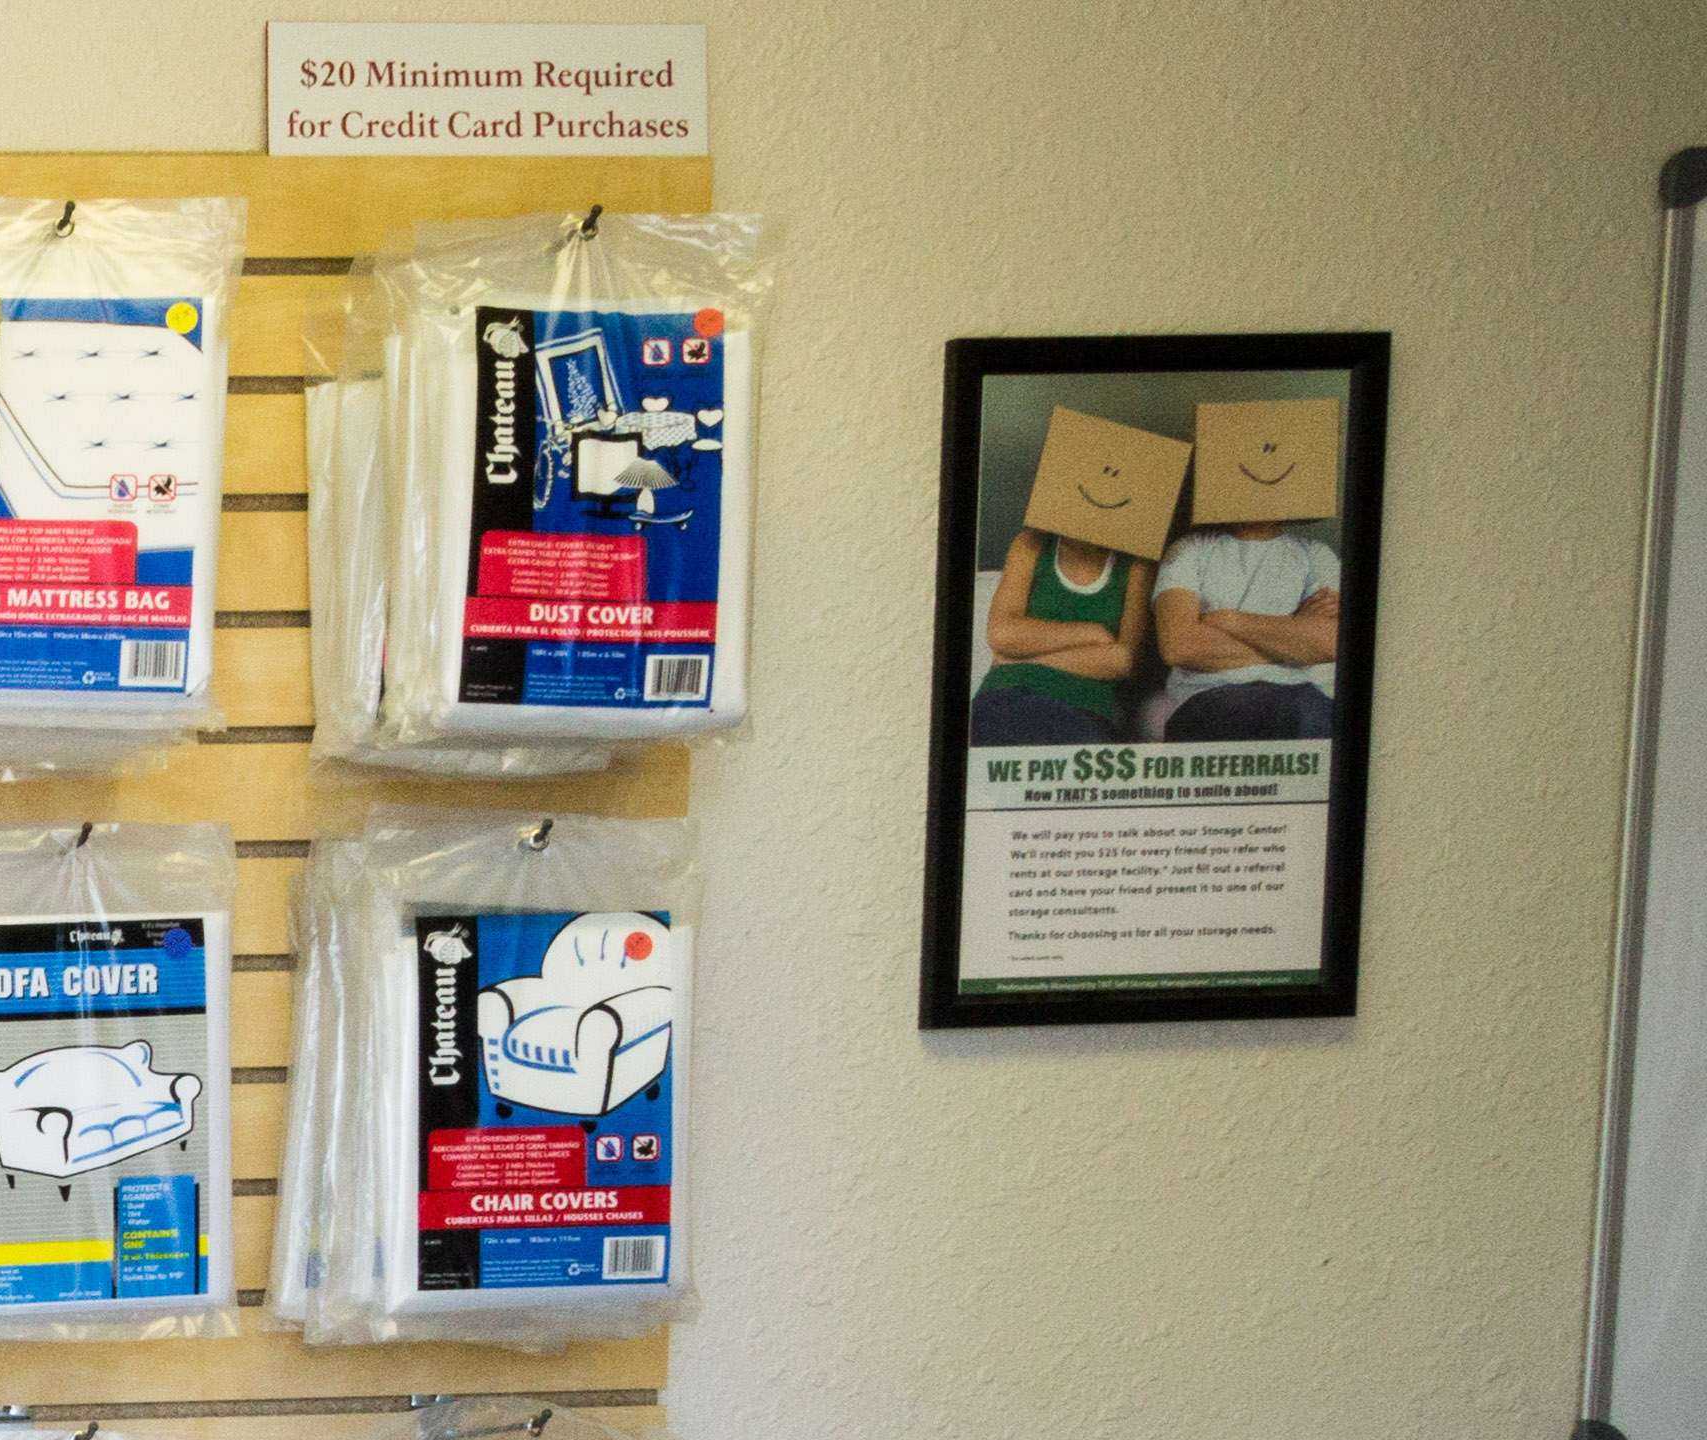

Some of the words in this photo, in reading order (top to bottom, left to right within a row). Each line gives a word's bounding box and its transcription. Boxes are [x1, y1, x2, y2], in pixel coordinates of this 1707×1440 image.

[300, 59, 355, 88] $20
[367, 61, 523, 88] Minimum
[534, 61, 674, 96] Required
[287, 110, 331, 138] for
[341, 111, 439, 138] Credit
[449, 112, 522, 138] Card
[533, 112, 689, 138] Purchases
[486, 356, 519, 485] Chateau
[7, 589, 118, 609] MATTRESS
[125, 591, 170, 609] BAG
[530, 603, 582, 622] DUST
[587, 605, 654, 625] COVER
[988, 761, 1021, 782] WE
[1028, 760, 1067, 781] PAY
[1073, 748, 1137, 781] $$$
[1143, 758, 1183, 779] FOR
[1190, 753, 1319, 777] REFERRALS!
[1056, 788, 1097, 800] THAT'S
[1101, 785, 1173, 799] something
[1178, 786, 1189, 798] to
[1193, 785, 1230, 797] smile
[1235, 783, 1277, 796] about!
[63, 963, 158, 996] COVER
[430, 968, 462, 1087] Chateau
[471, 1193, 537, 1211] CHAIR
[543, 1191, 618, 1209] COVERS
